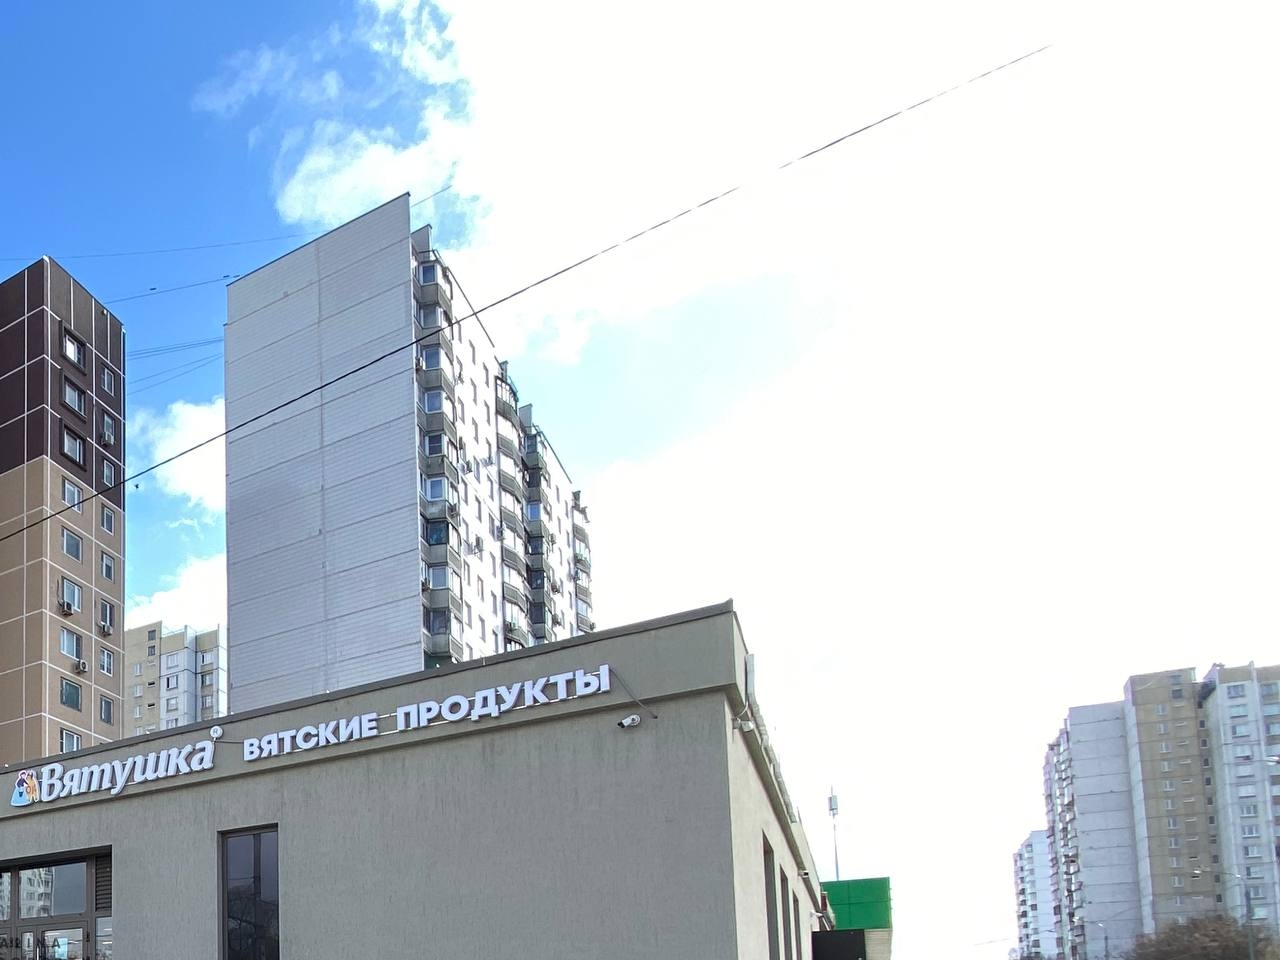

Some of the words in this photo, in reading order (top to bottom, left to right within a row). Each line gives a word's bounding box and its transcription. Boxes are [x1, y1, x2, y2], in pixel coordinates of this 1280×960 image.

[243, 712, 378, 761] ВЯТСКИЕ
[396, 664, 610, 731] ПРОДУКТЫ
[40, 740, 215, 802] Вятушка
